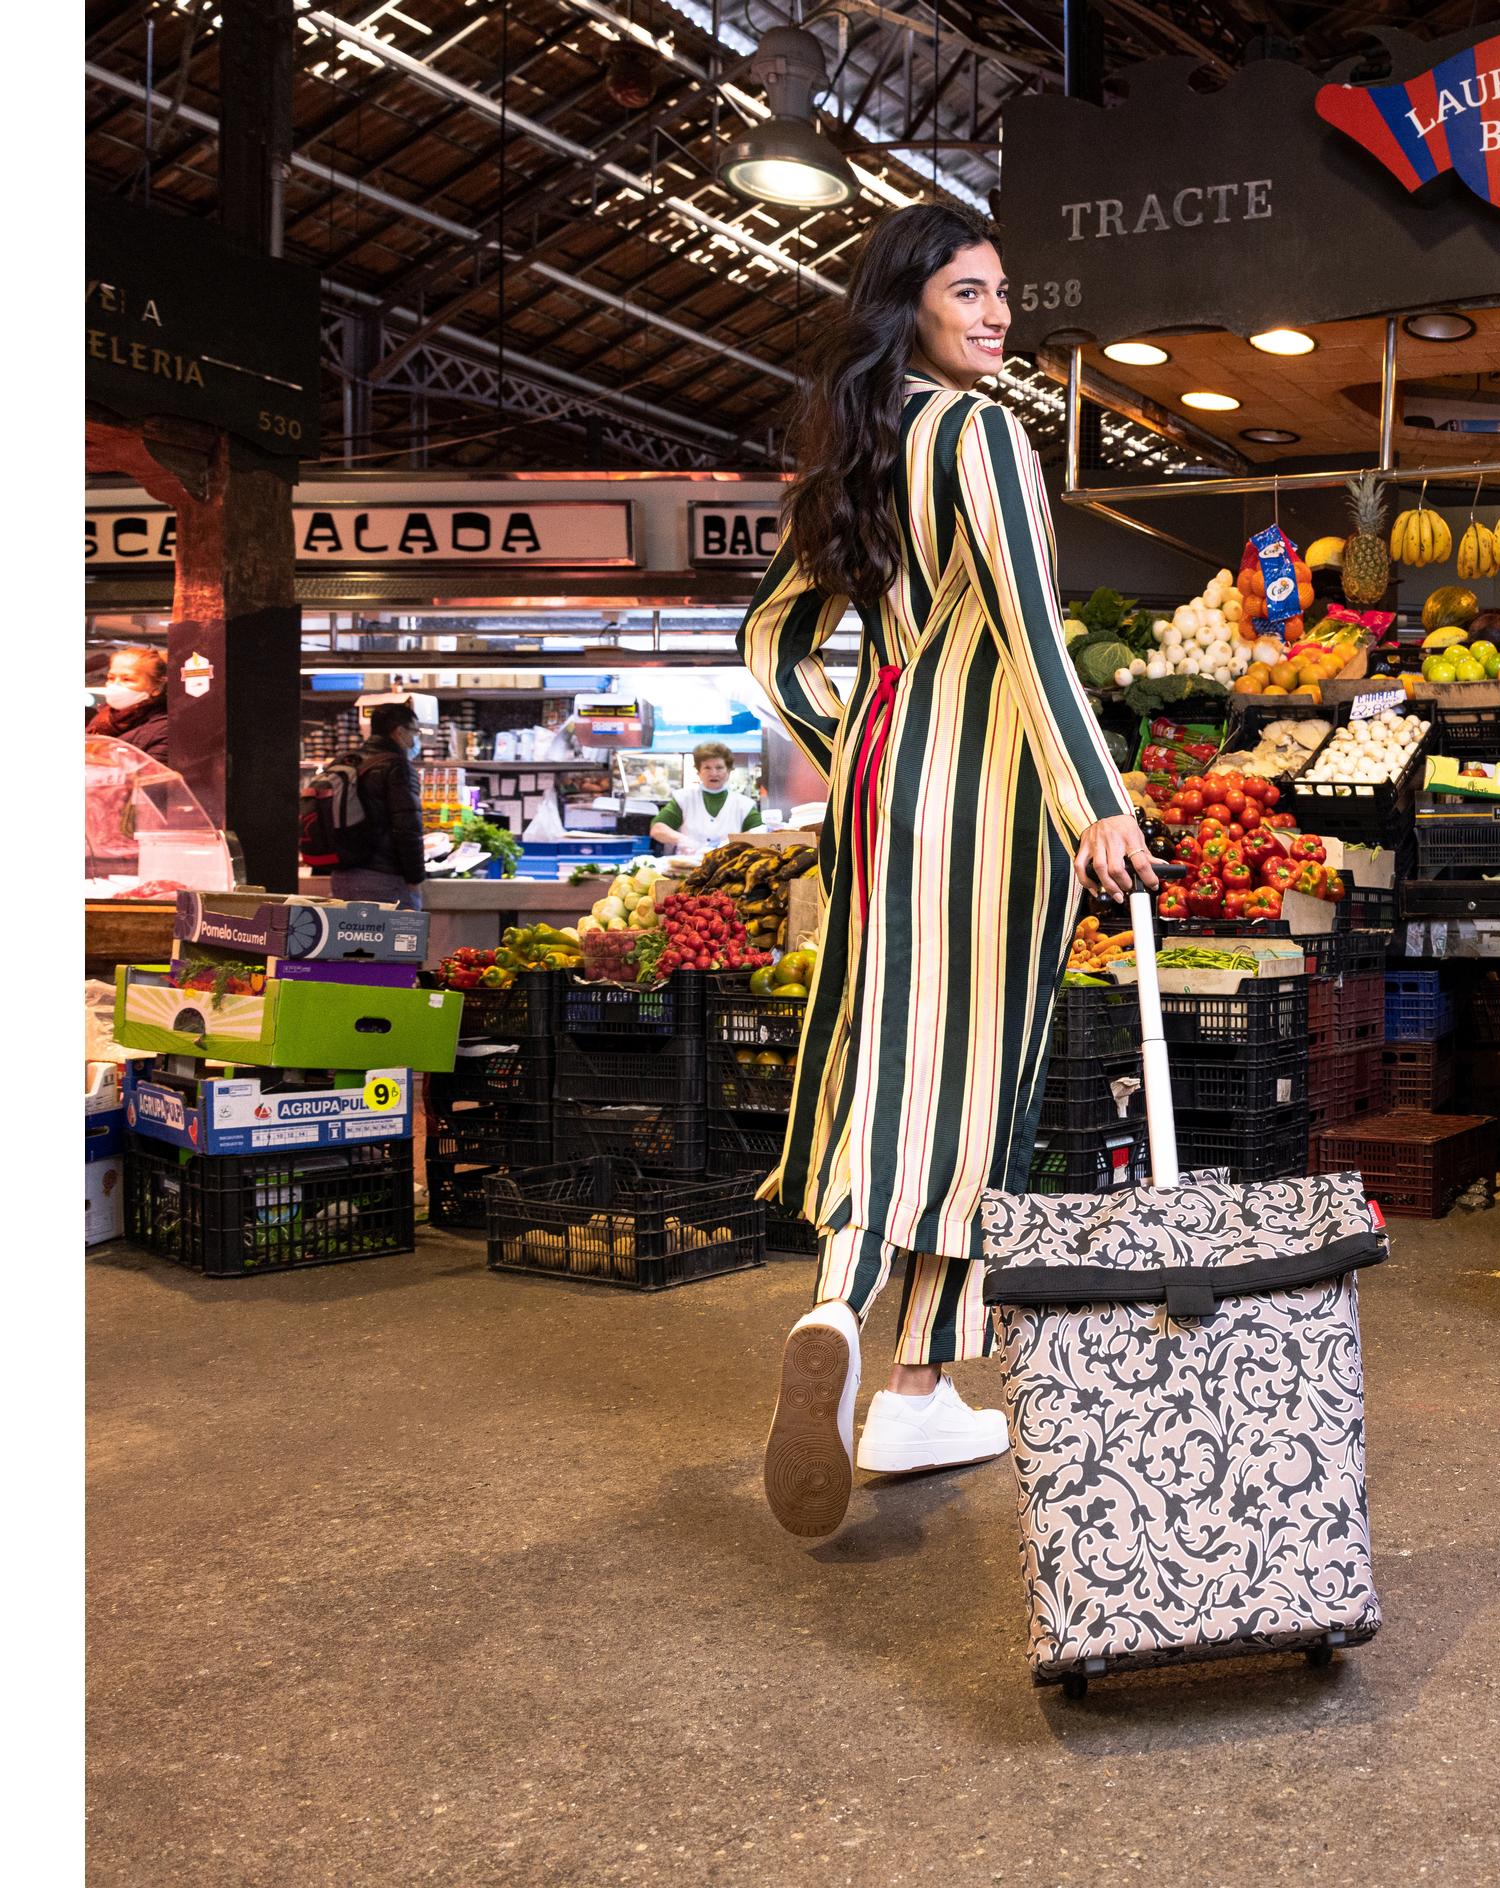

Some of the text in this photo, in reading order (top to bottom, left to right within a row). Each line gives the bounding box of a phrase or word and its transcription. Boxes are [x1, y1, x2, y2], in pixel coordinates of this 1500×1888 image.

[1062, 178, 1272, 242] TRACTE
[1021, 279, 1082, 312] 538
[141, 299, 162, 327] A
[258, 410, 301, 440] 530
[201, 920, 267, 946] Pomelo Cozumel
[337, 931, 384, 942] POMELO
[338, 921, 386, 933] Cozumel
[374, 1084, 389, 1105] 9
